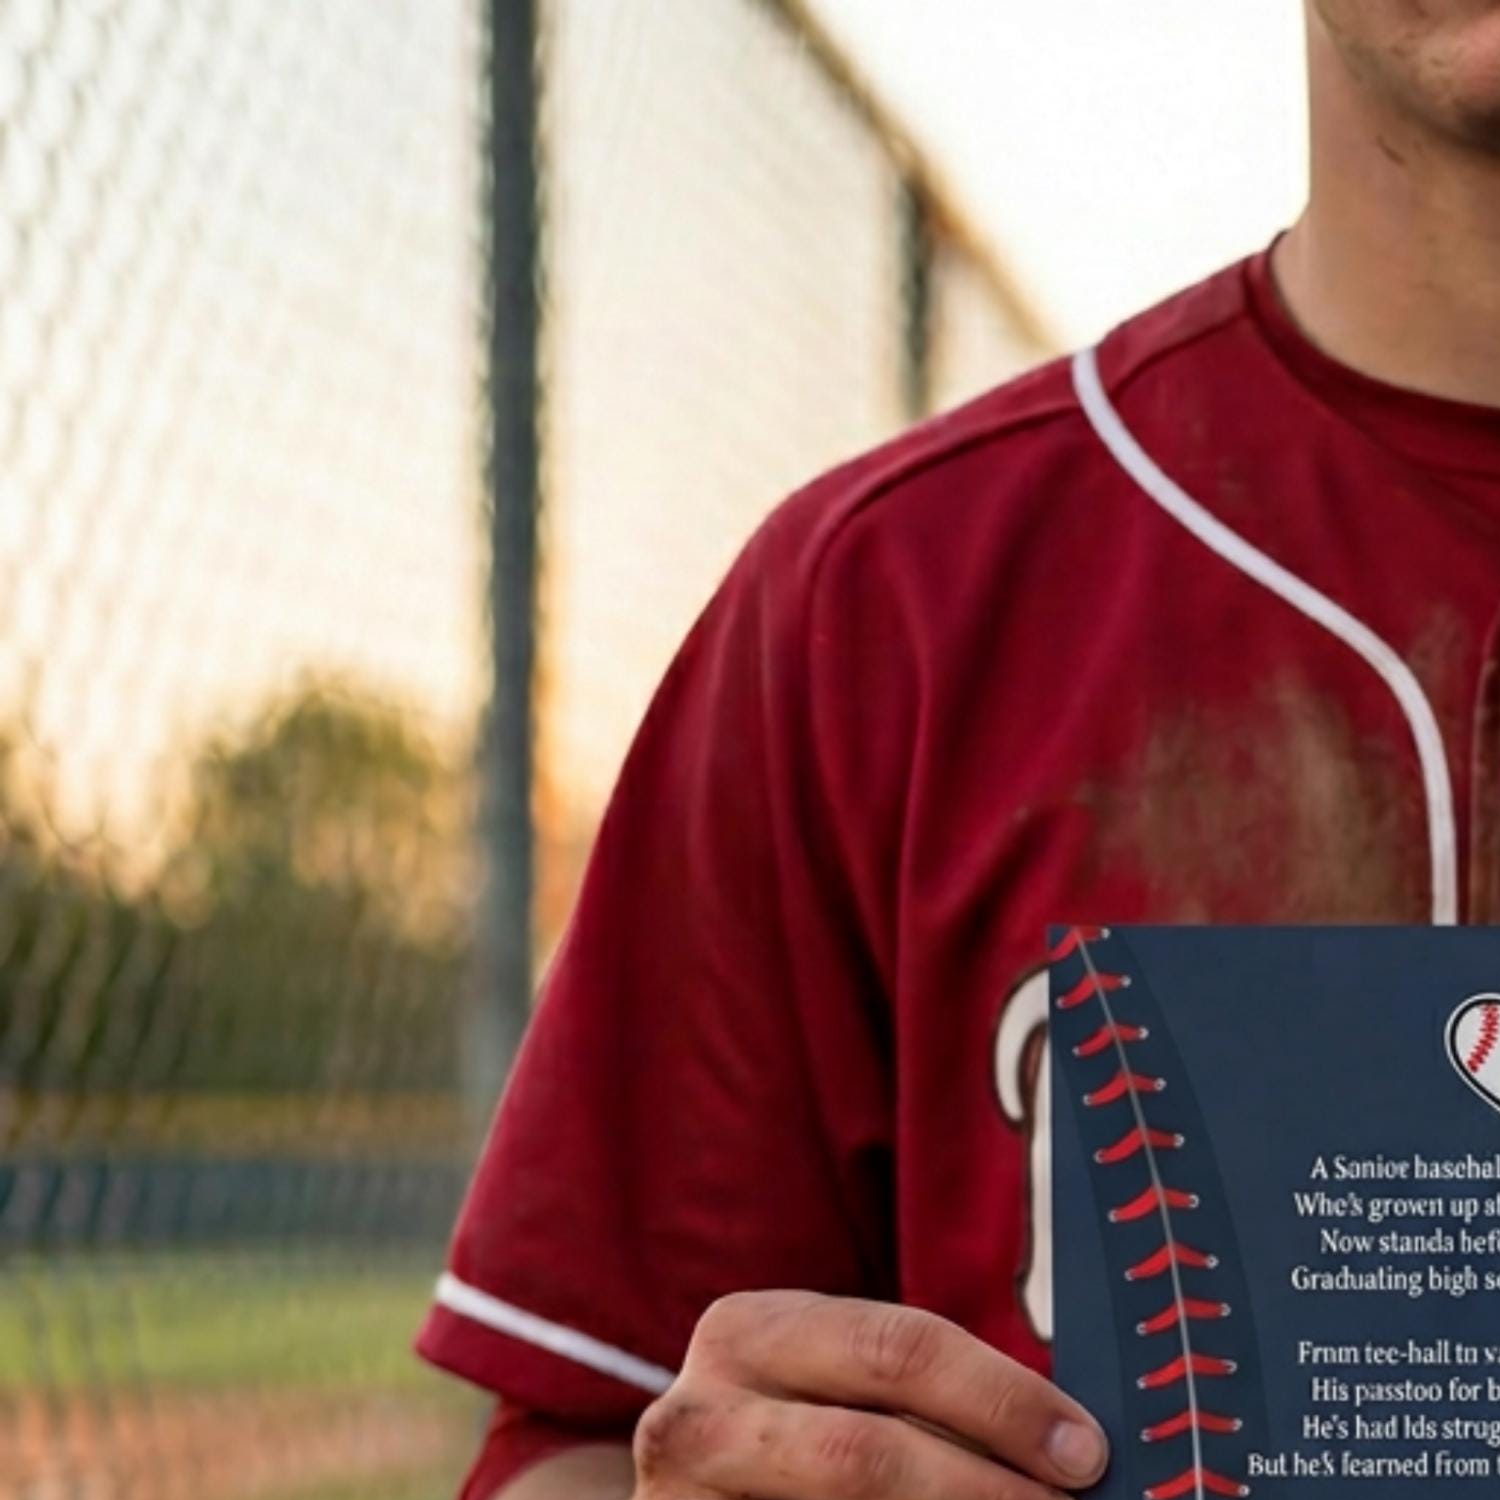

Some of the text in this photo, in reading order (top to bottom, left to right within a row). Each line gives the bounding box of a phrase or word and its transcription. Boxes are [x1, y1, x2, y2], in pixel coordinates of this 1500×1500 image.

[1310, 1156, 1329, 1180] A
[1450, 1198, 1479, 1223] up
[1320, 1228, 1374, 1253] Now
[1311, 1377, 1350, 1402] His
[1448, 1376, 1483, 1402] for
[1303, 1414, 1349, 1439] He's
[1355, 1414, 1398, 1440] had
